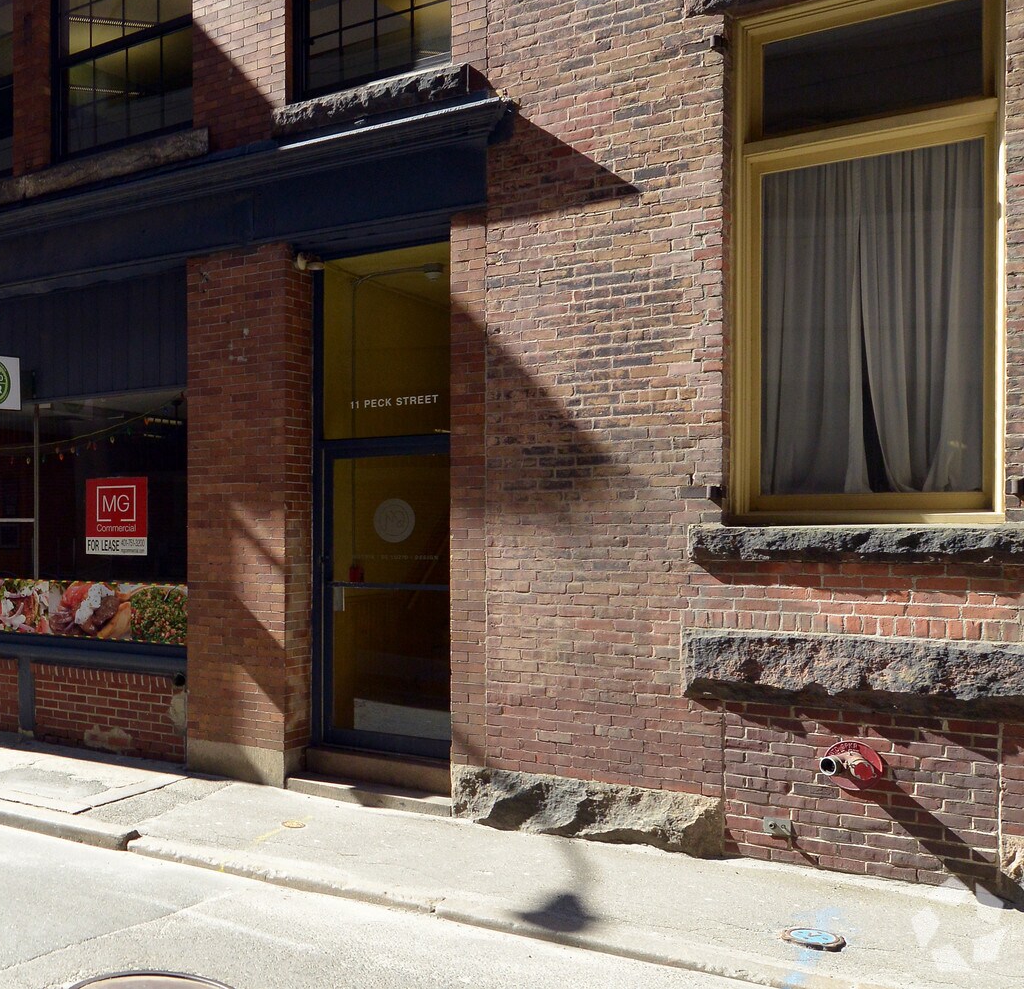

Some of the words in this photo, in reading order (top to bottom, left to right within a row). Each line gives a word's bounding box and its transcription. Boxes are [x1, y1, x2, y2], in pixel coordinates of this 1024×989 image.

[350, 401, 360, 410] 11
[364, 398, 392, 408] PECK
[396, 394, 439, 406] STREET
[102, 494, 130, 512] MG
[97, 523, 136, 532] Commercial
[87, 539, 100, 551] FOR
[101, 539, 120, 552] LEASE
